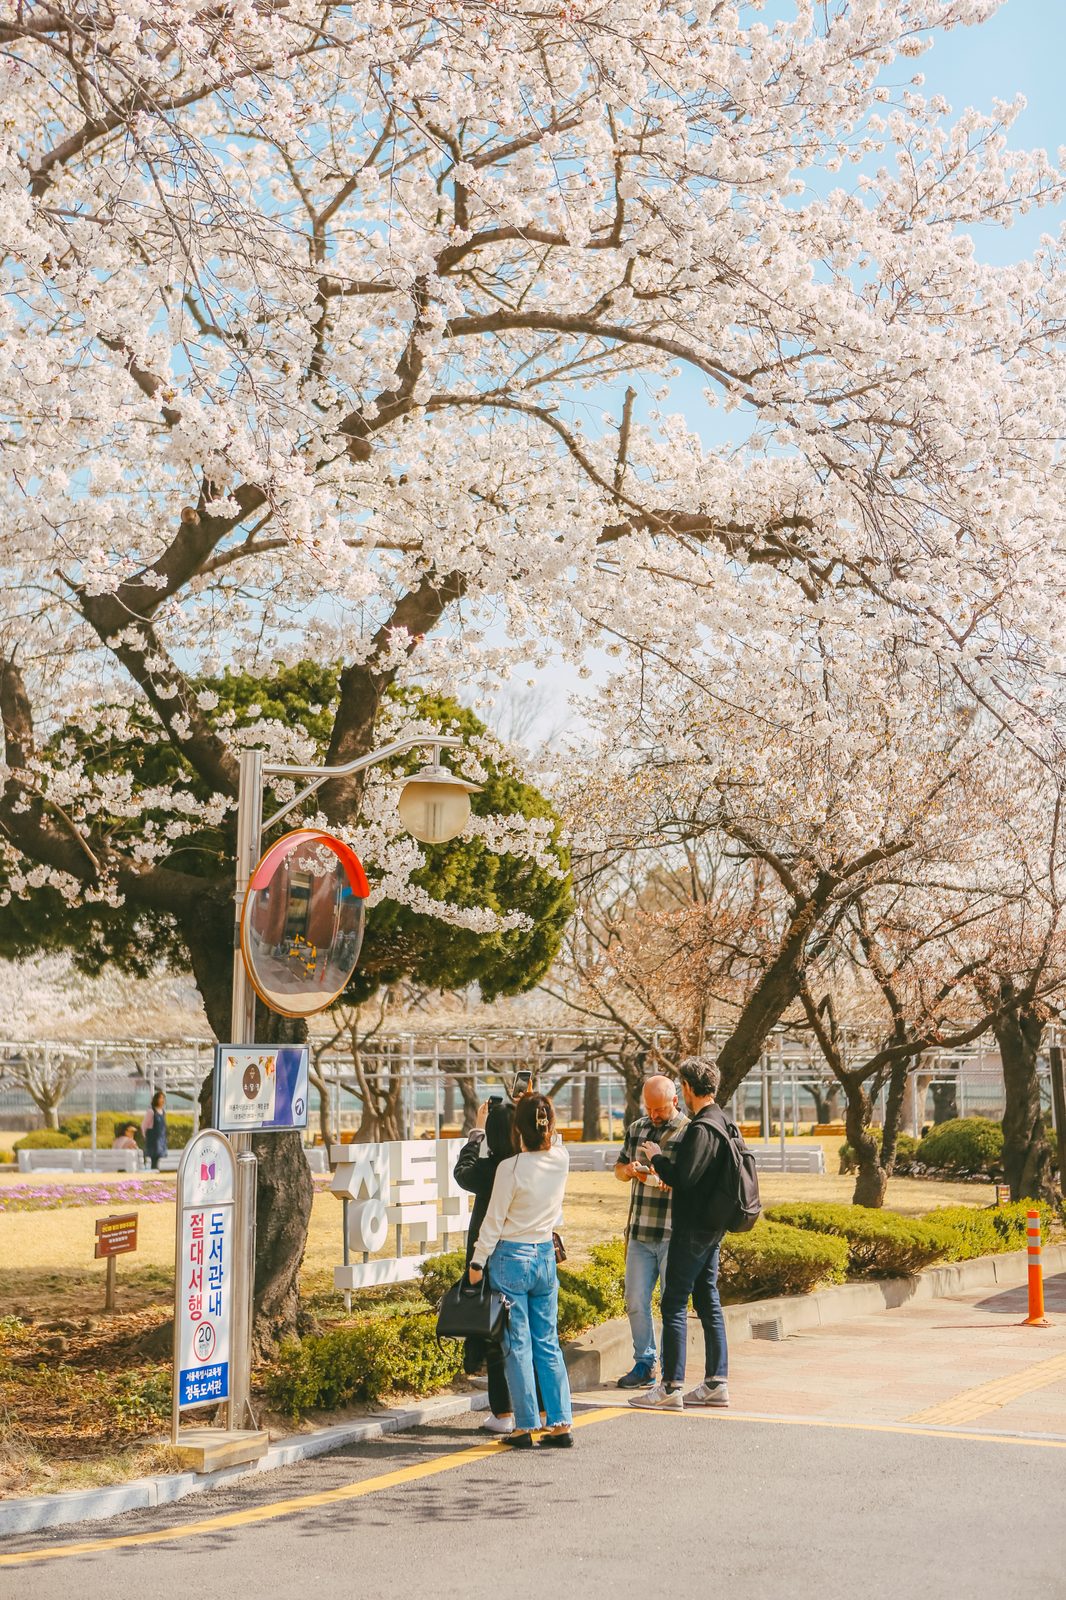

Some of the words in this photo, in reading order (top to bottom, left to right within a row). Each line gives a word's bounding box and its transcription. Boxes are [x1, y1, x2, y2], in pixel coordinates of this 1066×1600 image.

[188, 1213, 204, 1321] 절대서행
[198, 1326, 212, 1343] 20
[185, 1379, 222, 1401] 정독도서관
